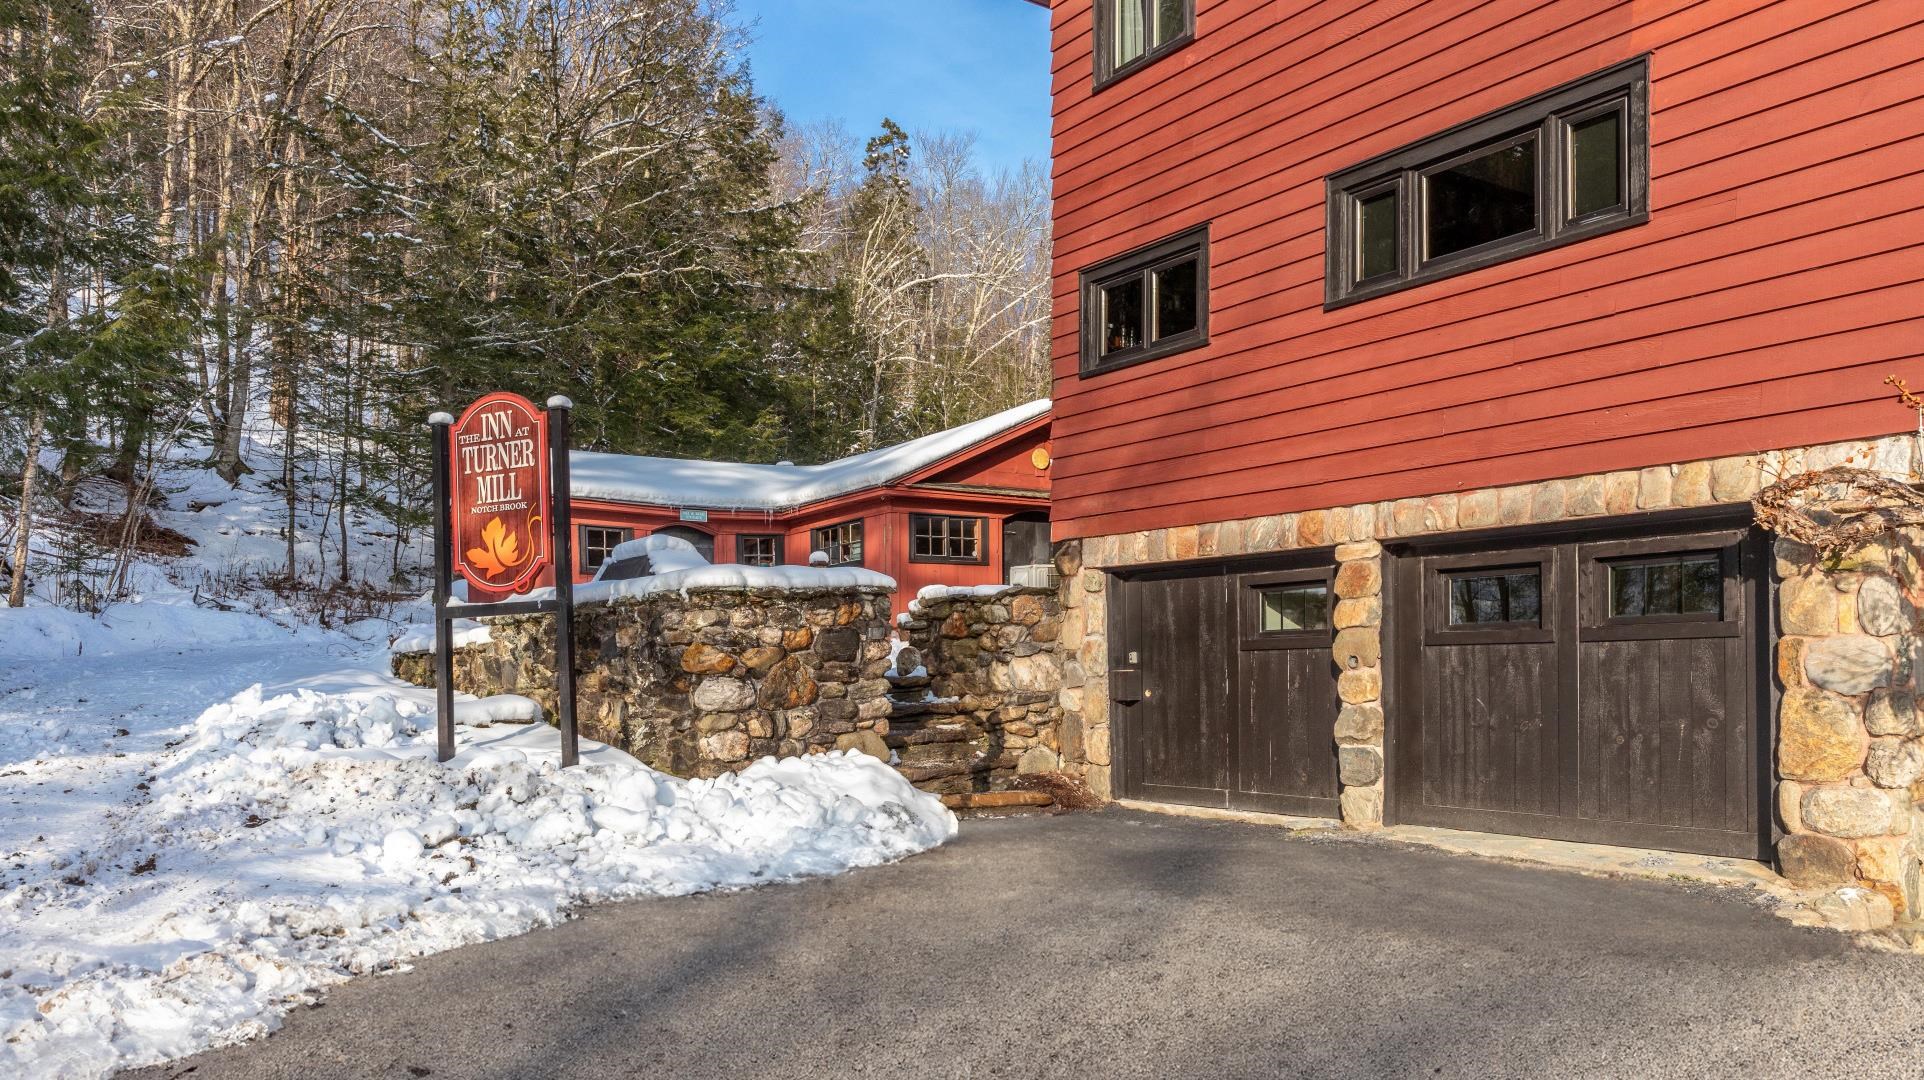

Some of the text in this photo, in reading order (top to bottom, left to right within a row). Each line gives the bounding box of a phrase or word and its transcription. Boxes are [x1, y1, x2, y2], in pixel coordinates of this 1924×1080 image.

[459, 410, 529, 444] THE INN AT
[462, 439, 535, 474] TURNER
[476, 472, 522, 504] MILL
[471, 502, 527, 514] NOTCH BROOK
